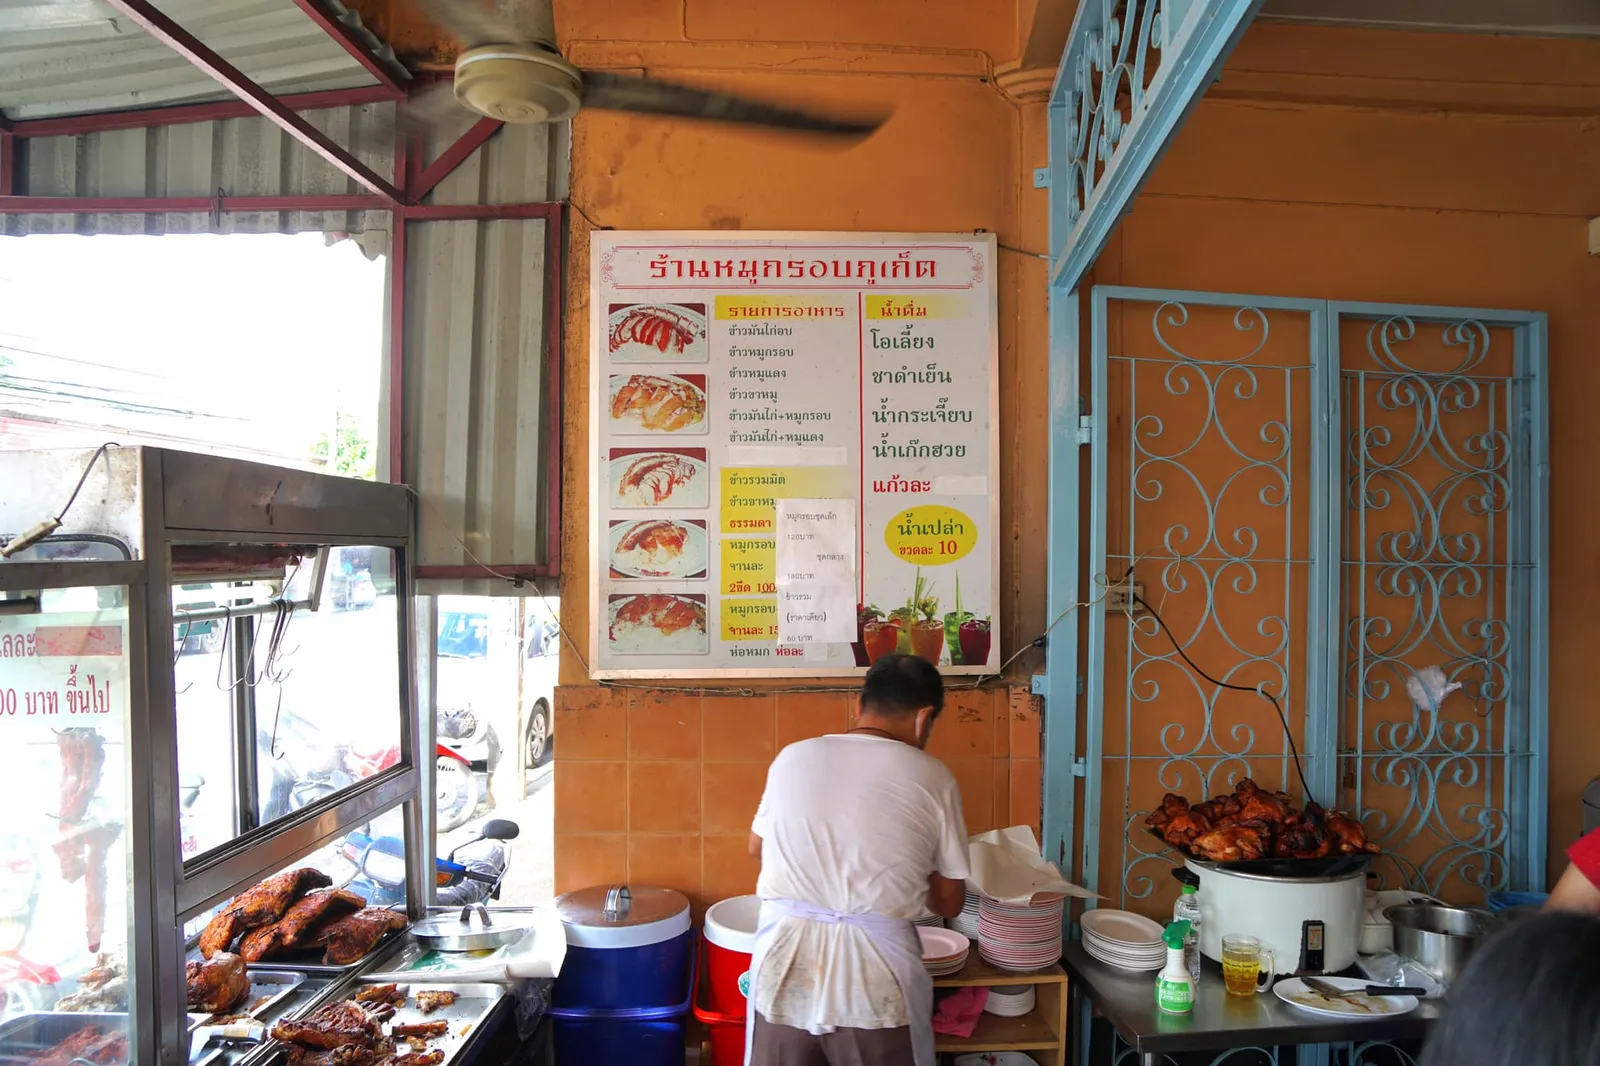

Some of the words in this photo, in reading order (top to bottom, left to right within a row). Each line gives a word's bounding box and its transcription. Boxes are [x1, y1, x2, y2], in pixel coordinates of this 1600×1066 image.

[650, 250, 936, 284] ร้านหมูกรอบภูเก็ต
[729, 306, 844, 317] รายการอาหาร
[881, 300, 927, 317] น้ำดื่ม
[729, 323, 792, 336] ข้าวมันไก่อบ
[870, 324, 934, 349] โอเลี้ยง
[729, 345, 794, 361] ข้าวหมูกรอบ
[729, 367, 787, 382] ข้าวหมูแดง
[872, 363, 952, 384] ชาดำเย็น
[729, 387, 777, 403] ข้าวขาหมู
[872, 397, 972, 423] น้ำกระเจี๊ยบ
[872, 432, 966, 458] น้ำเก๊กฮวย
[873, 474, 931, 493] แก้วละ
[729, 519, 771, 529] ธรรมดา
[897, 512, 963, 535] น้ำเปล่า
[729, 541, 776, 553] หมูกรอบ
[899, 546, 933, 555] ขวดละ
[939, 539, 958, 555] 10
[730, 561, 764, 571] จานละ
[729, 605, 776, 618] หมูกรอบ
[729, 626, 763, 636] จานละ
[0, 633, 36, 658] ลละ
[729, 645, 770, 656] ห่อหมก
[775, 644, 804, 656] ห่อละ
[25, 691, 58, 715] บาท
[66, 664, 110, 714] ขึ้นไป
